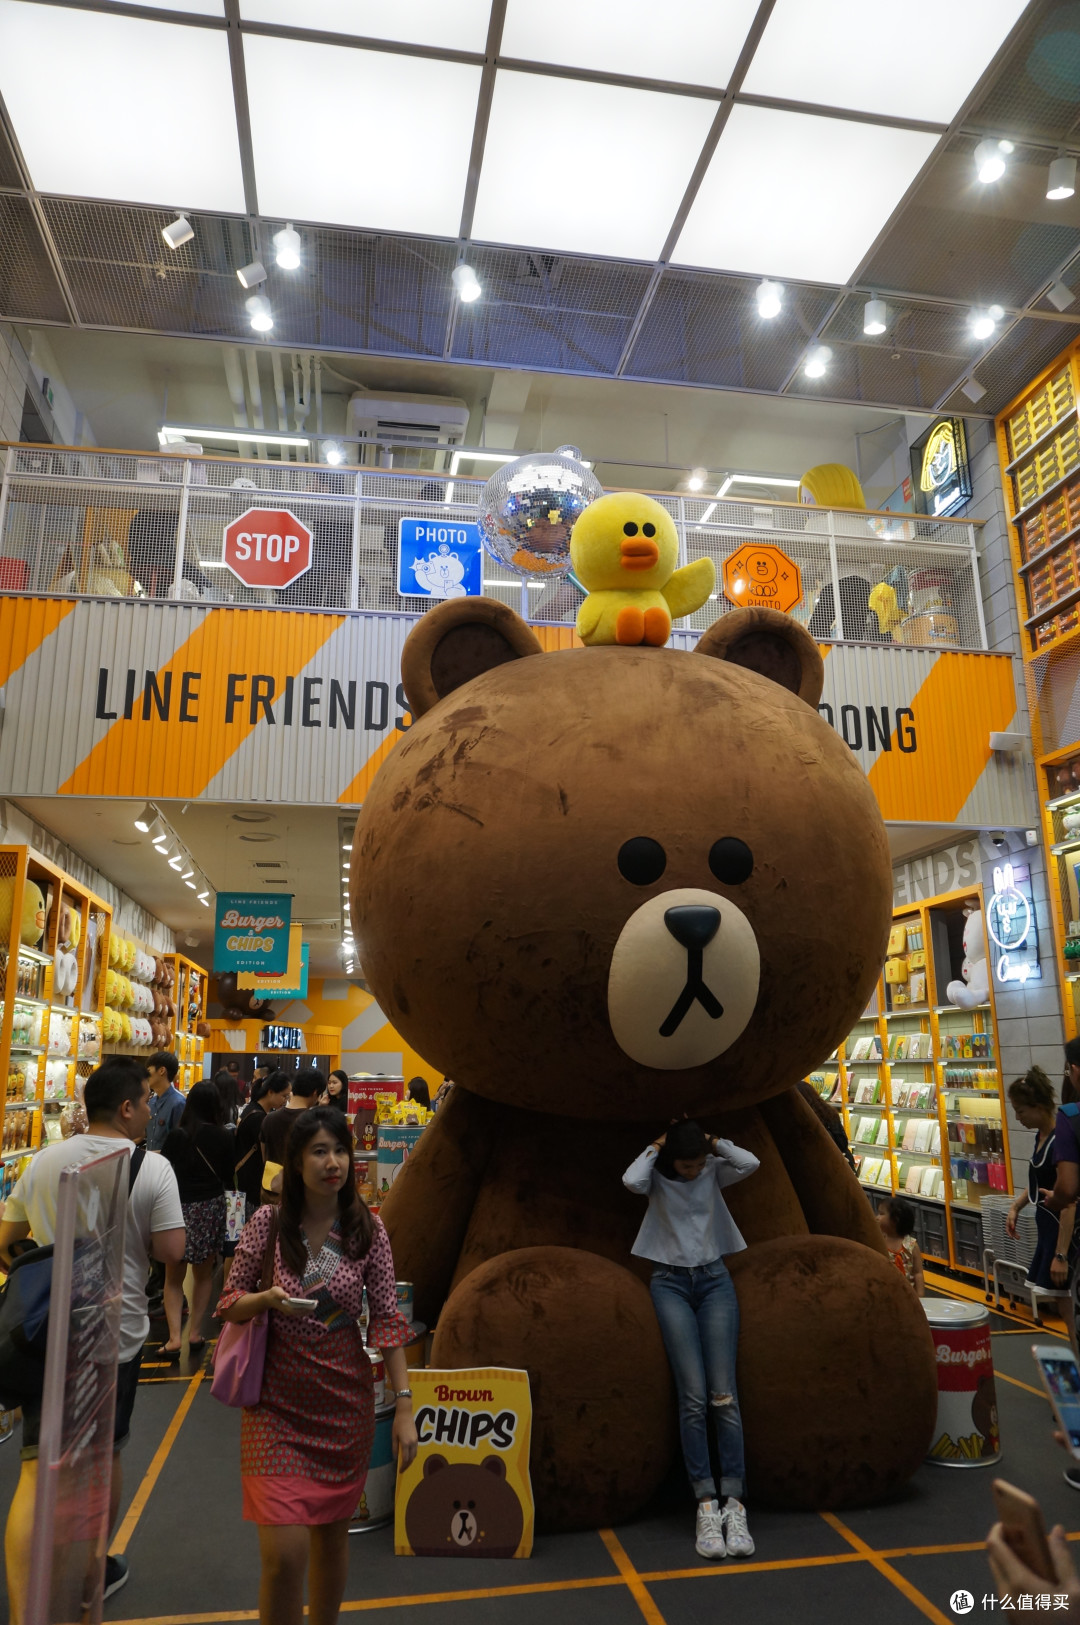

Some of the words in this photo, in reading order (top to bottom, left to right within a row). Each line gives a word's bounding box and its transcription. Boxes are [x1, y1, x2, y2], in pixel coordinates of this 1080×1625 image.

[415, 526, 467, 544] PHOTO
[235, 532, 300, 563] STOP
[747, 599, 781, 610] PHOTO
[95, 668, 202, 722] LINE
[225, 673, 416, 732] FRIENDS
[221, 910, 285, 933] Burger
[226, 935, 275, 953] CHIPS
[268, 1025, 302, 1049] CASHIER
[253, 1056, 258, 1070] 1
[295, 1056, 300, 1069] 3
[311, 1056, 317, 1069] 4
[378, 1136, 408, 1152] Burger
[936, 1344, 987, 1368] Burger
[434, 1384, 494, 1402] Brown
[414, 1405, 517, 1450] CHIPS
